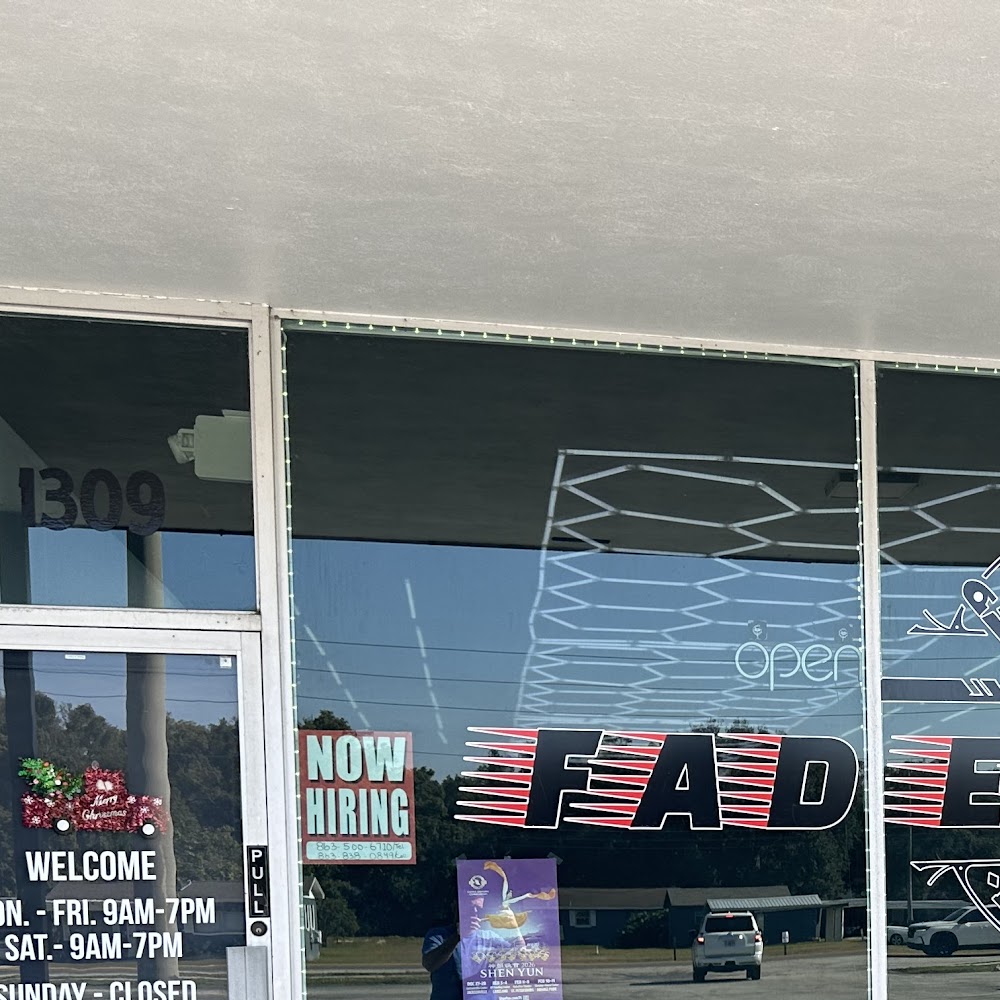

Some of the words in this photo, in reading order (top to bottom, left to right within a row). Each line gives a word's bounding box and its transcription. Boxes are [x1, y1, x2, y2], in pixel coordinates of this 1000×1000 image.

[19, 467, 165, 536] 1309
[307, 735, 406, 783] NOW
[306, 788, 410, 837] HIRING
[25, 851, 157, 882] WELCOME
[251, 849, 264, 914] PULL
[53, 899, 97, 926] FRI.
[103, 897, 216, 925] 9AM-7PM
[69, 932, 183, 960] 9AM-7PM
[480, 968, 514, 979] SHEN
[517, 967, 544, 977] YUN
